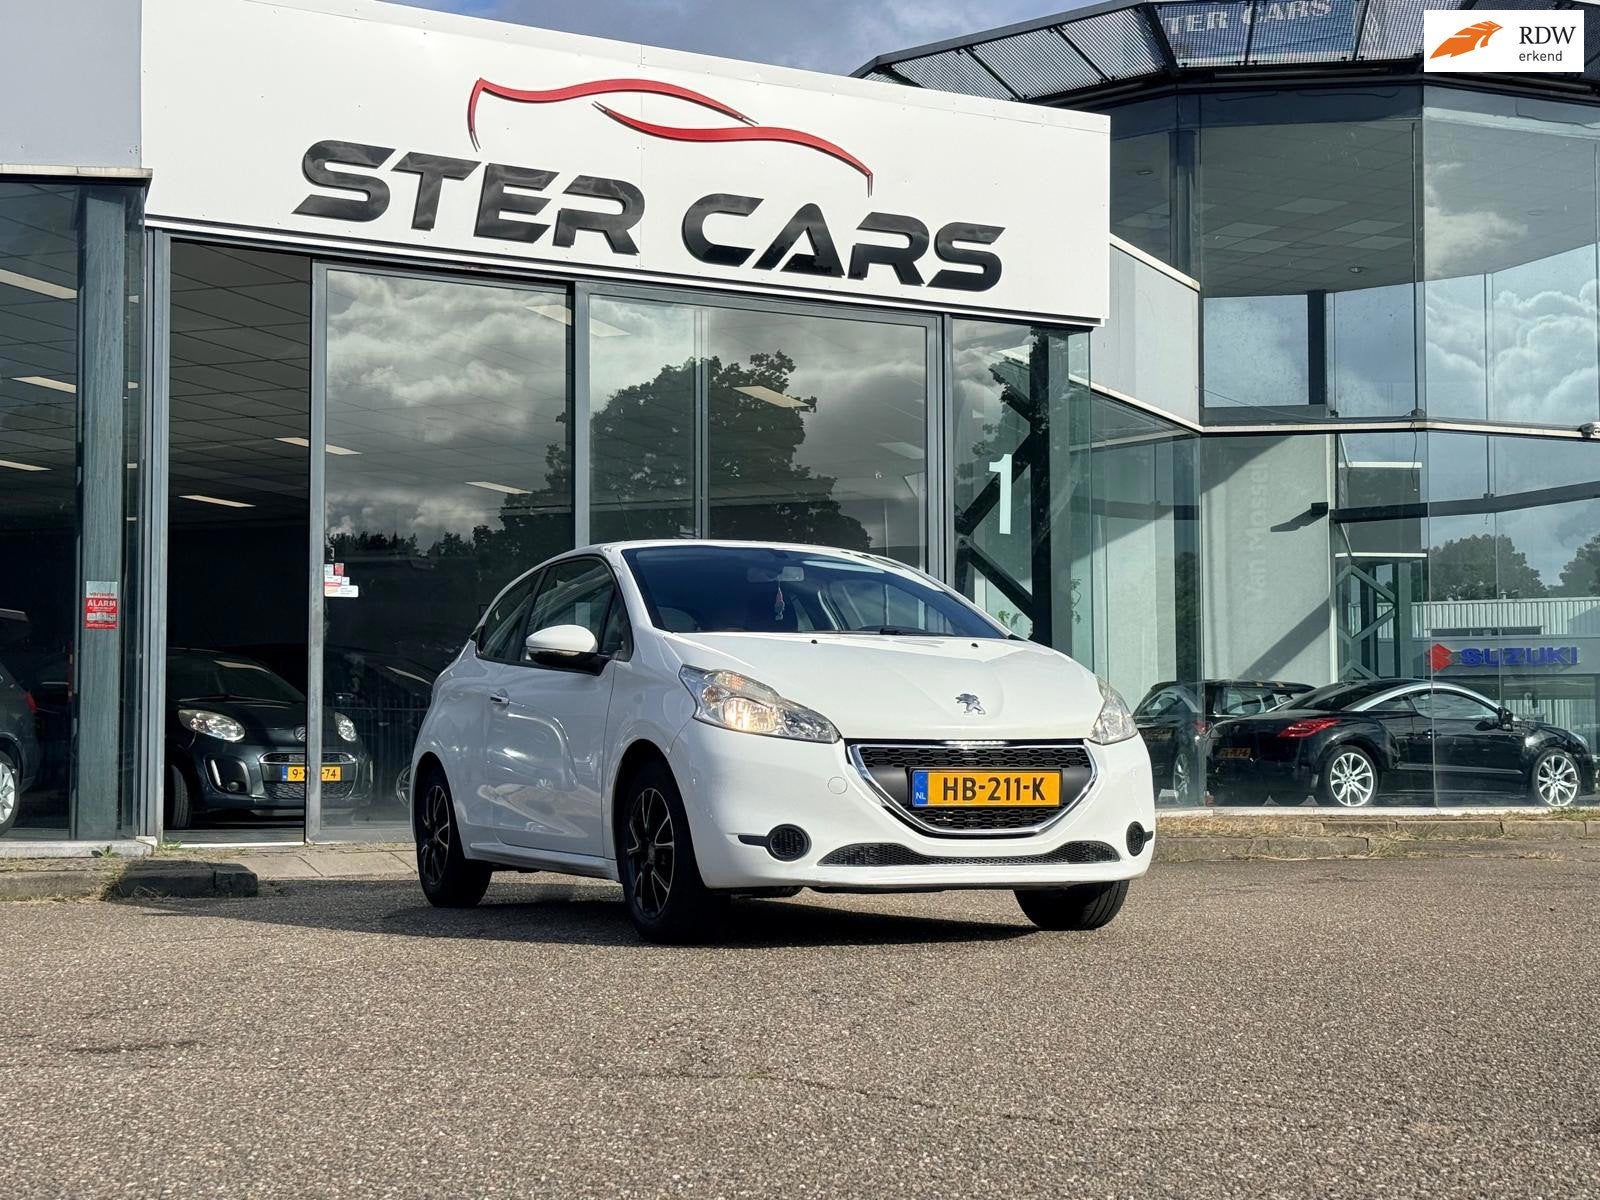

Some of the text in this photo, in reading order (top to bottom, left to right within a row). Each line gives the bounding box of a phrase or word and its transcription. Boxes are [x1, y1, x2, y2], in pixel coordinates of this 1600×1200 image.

[1161, 11, 1228, 34] TER
[292, 139, 1006, 292] STER CARS
[989, 453, 1013, 535] 1
[87, 599, 117, 607] ALARM
[1460, 647, 1579, 667] SUZUKI
[292, 768, 337, 780] 9--74
[915, 792, 927, 800] NL
[942, 777, 1046, 801] HB-211-K
